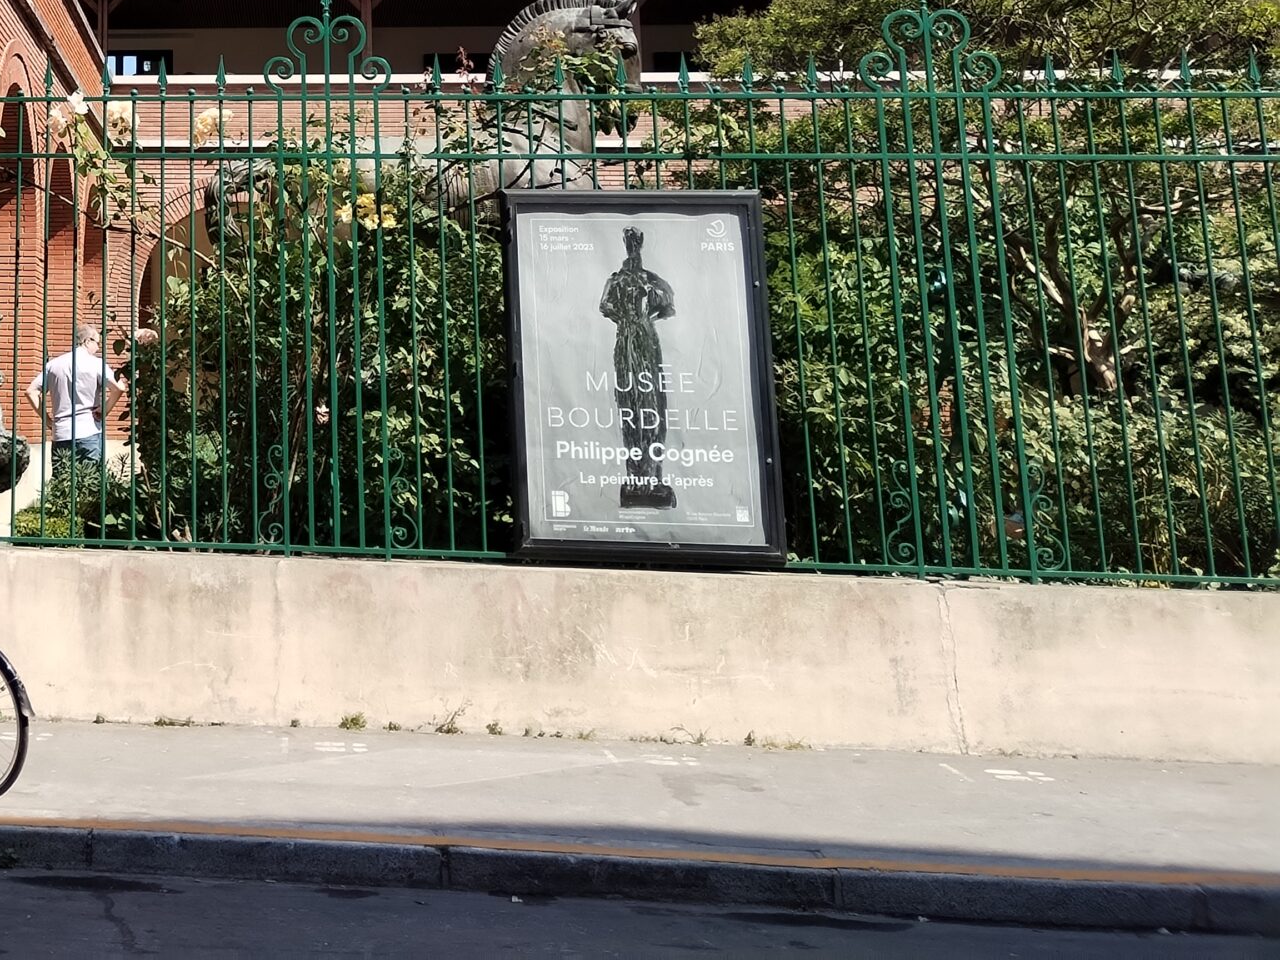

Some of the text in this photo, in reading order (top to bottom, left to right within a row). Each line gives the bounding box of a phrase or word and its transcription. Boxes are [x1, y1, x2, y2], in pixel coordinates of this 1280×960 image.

[538, 225, 579, 234] Exposition
[539, 234, 548, 242] 15
[550, 243, 571, 252] juillet
[573, 243, 594, 251] 2023
[700, 242, 735, 251] PARIS
[586, 364, 695, 393] MUSÉE
[547, 406, 739, 431] BOURDELLE
[556, 440, 734, 467] Philippe Cognée
[580, 472, 714, 488] La peinture d'après
